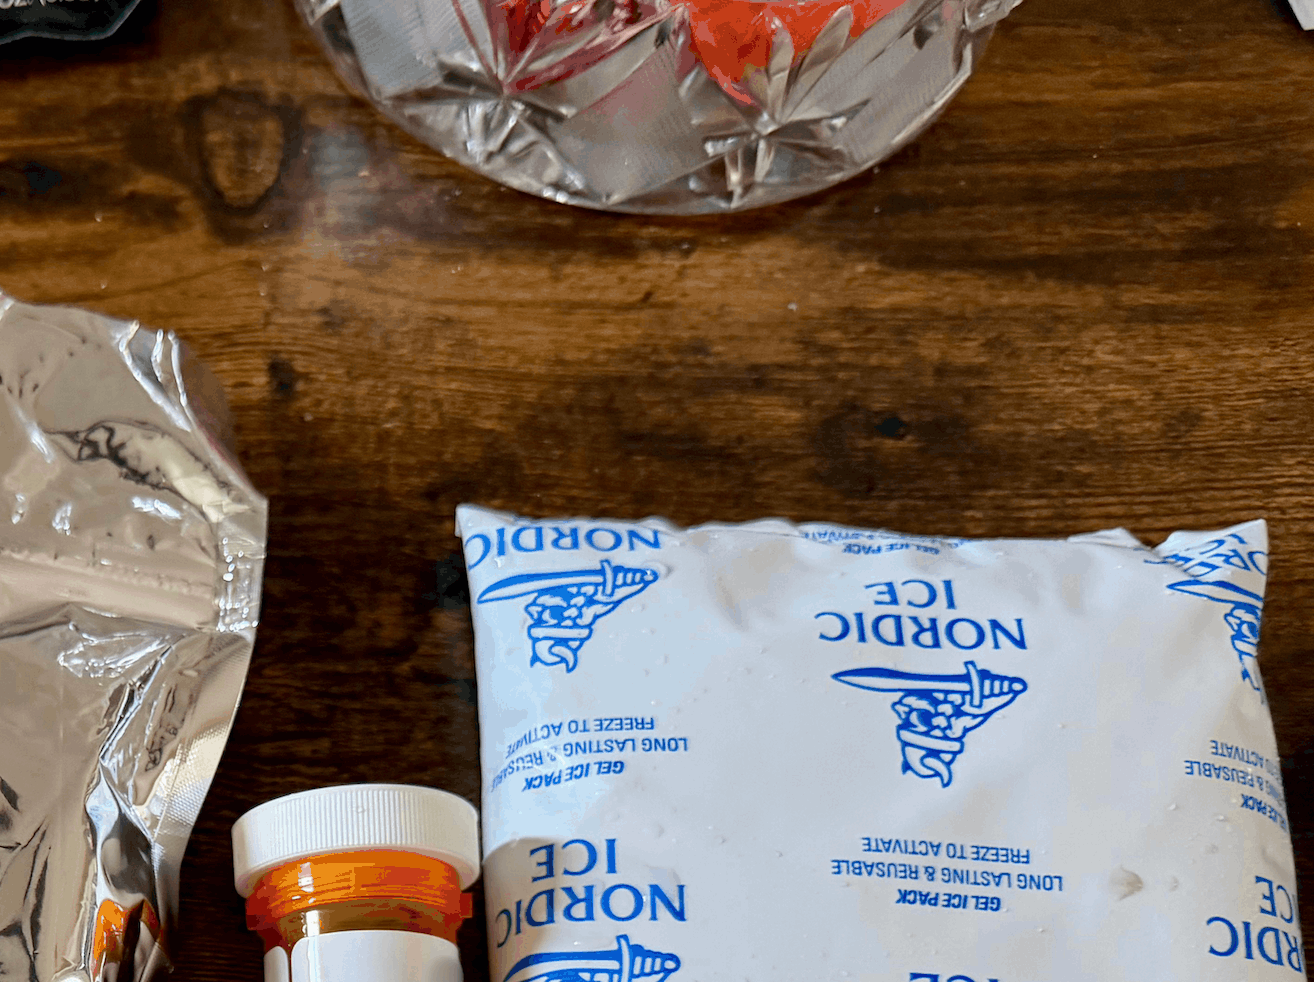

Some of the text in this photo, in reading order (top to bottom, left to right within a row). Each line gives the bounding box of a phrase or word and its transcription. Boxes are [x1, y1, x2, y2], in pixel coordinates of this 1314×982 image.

[464, 525, 662, 571] NORDIC
[864, 579, 957, 610] ICE
[814, 612, 1028, 651] NORDIC
[568, 719, 591, 734] TO
[594, 717, 655, 731] FREEZE
[562, 738, 636, 758] LASTING
[641, 737, 689, 752] LONG
[521, 760, 625, 793] GEL ICE PACK
[1184, 760, 1254, 788] REUSABLE
[529, 838, 618, 883] ICE
[861, 837, 1030, 864] FREEZE TO ACTIVATE
[831, 859, 1063, 891] LONG LASTING & REUSABLE
[495, 883, 687, 948] NORDIC
[896, 889, 1002, 912] GEL ICE PACK
[1205, 917, 1303, 973] RDIC
